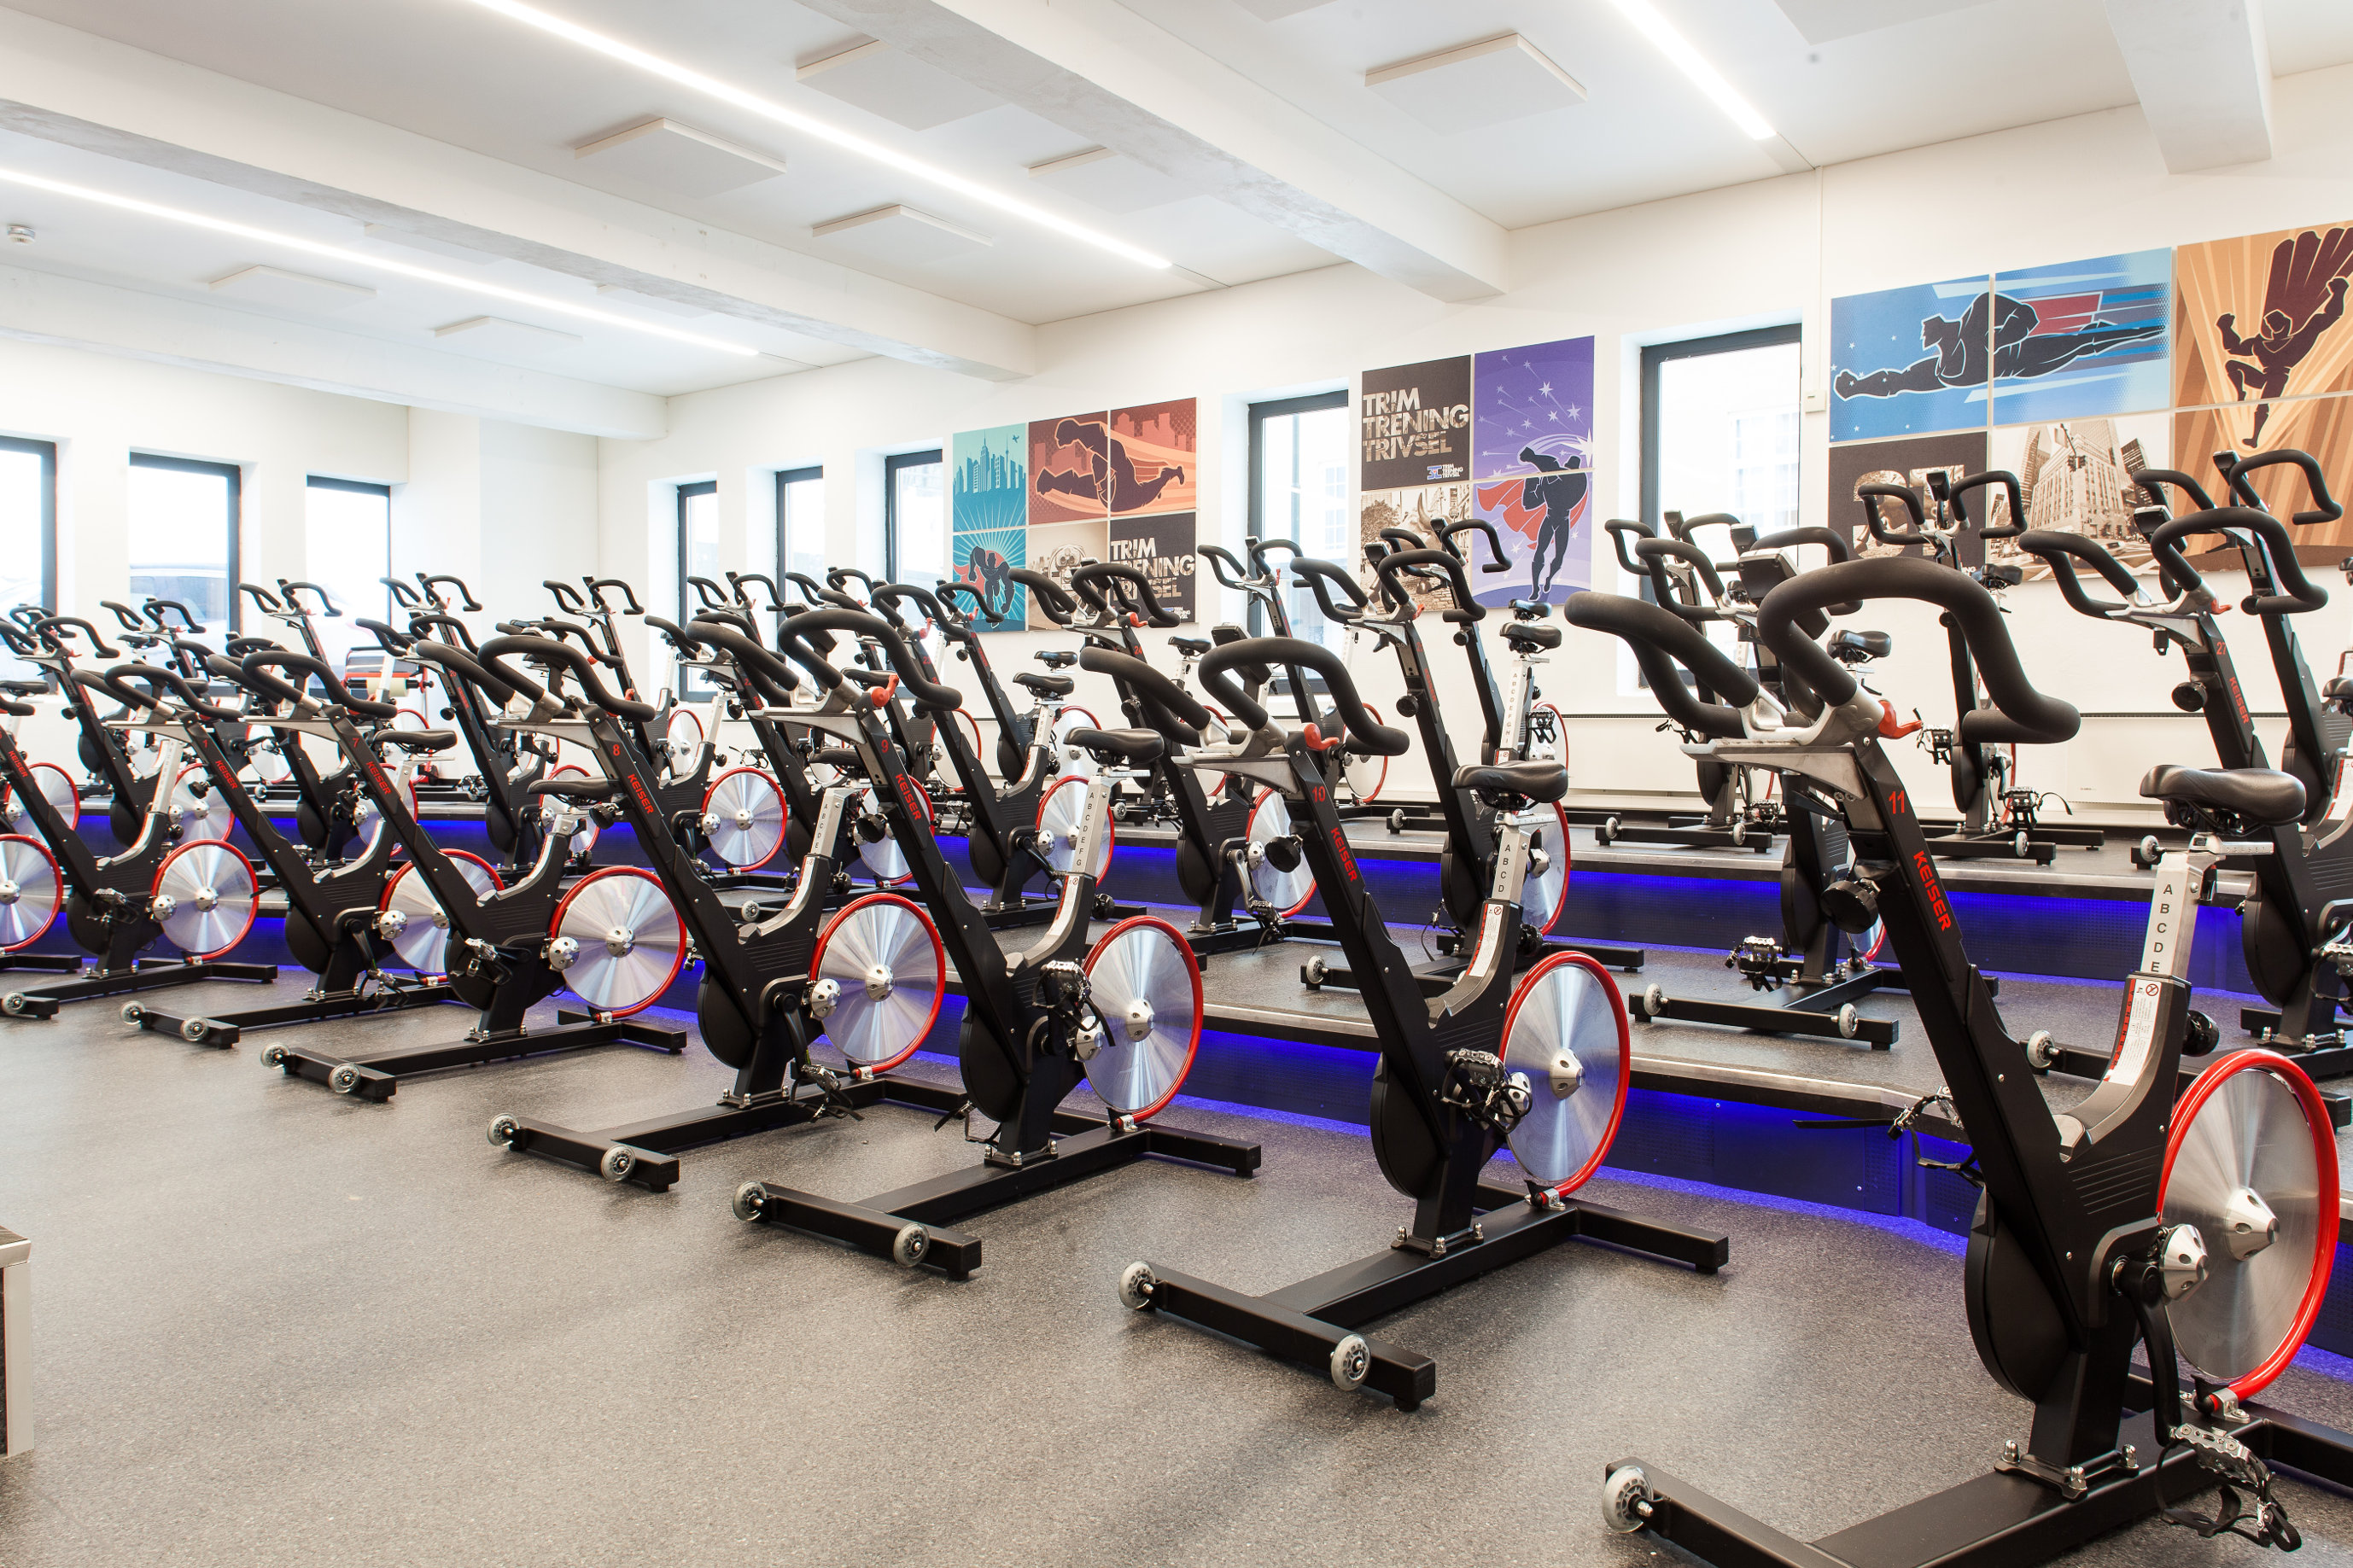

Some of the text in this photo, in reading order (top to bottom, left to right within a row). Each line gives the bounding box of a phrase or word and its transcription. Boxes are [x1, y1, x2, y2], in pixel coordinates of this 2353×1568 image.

[1363, 387, 1421, 417] TRIM
[1363, 404, 1470, 439] TRENING
[1362, 431, 1452, 463] TRIVSEL
[1111, 537, 1157, 561] TRIM
[1133, 645, 1143, 656] 24
[2229, 676, 2251, 725] KEISER
[352, 737, 360, 749] 7
[612, 743, 622, 757] 8
[880, 739, 890, 754] 9
[8, 749, 29, 778] KEISER
[214, 760, 238, 790] KEISER
[365, 761, 392, 795] KEISER
[627, 773, 655, 815] KEISER
[895, 773, 922, 820] KEISER
[1311, 785, 1326, 803] 10
[1888, 790, 1906, 815] 11
[1329, 826, 1358, 883] KEISER
[1912, 850, 1953, 932] KEISER
[2151, 883, 2173, 973] A B C D E
